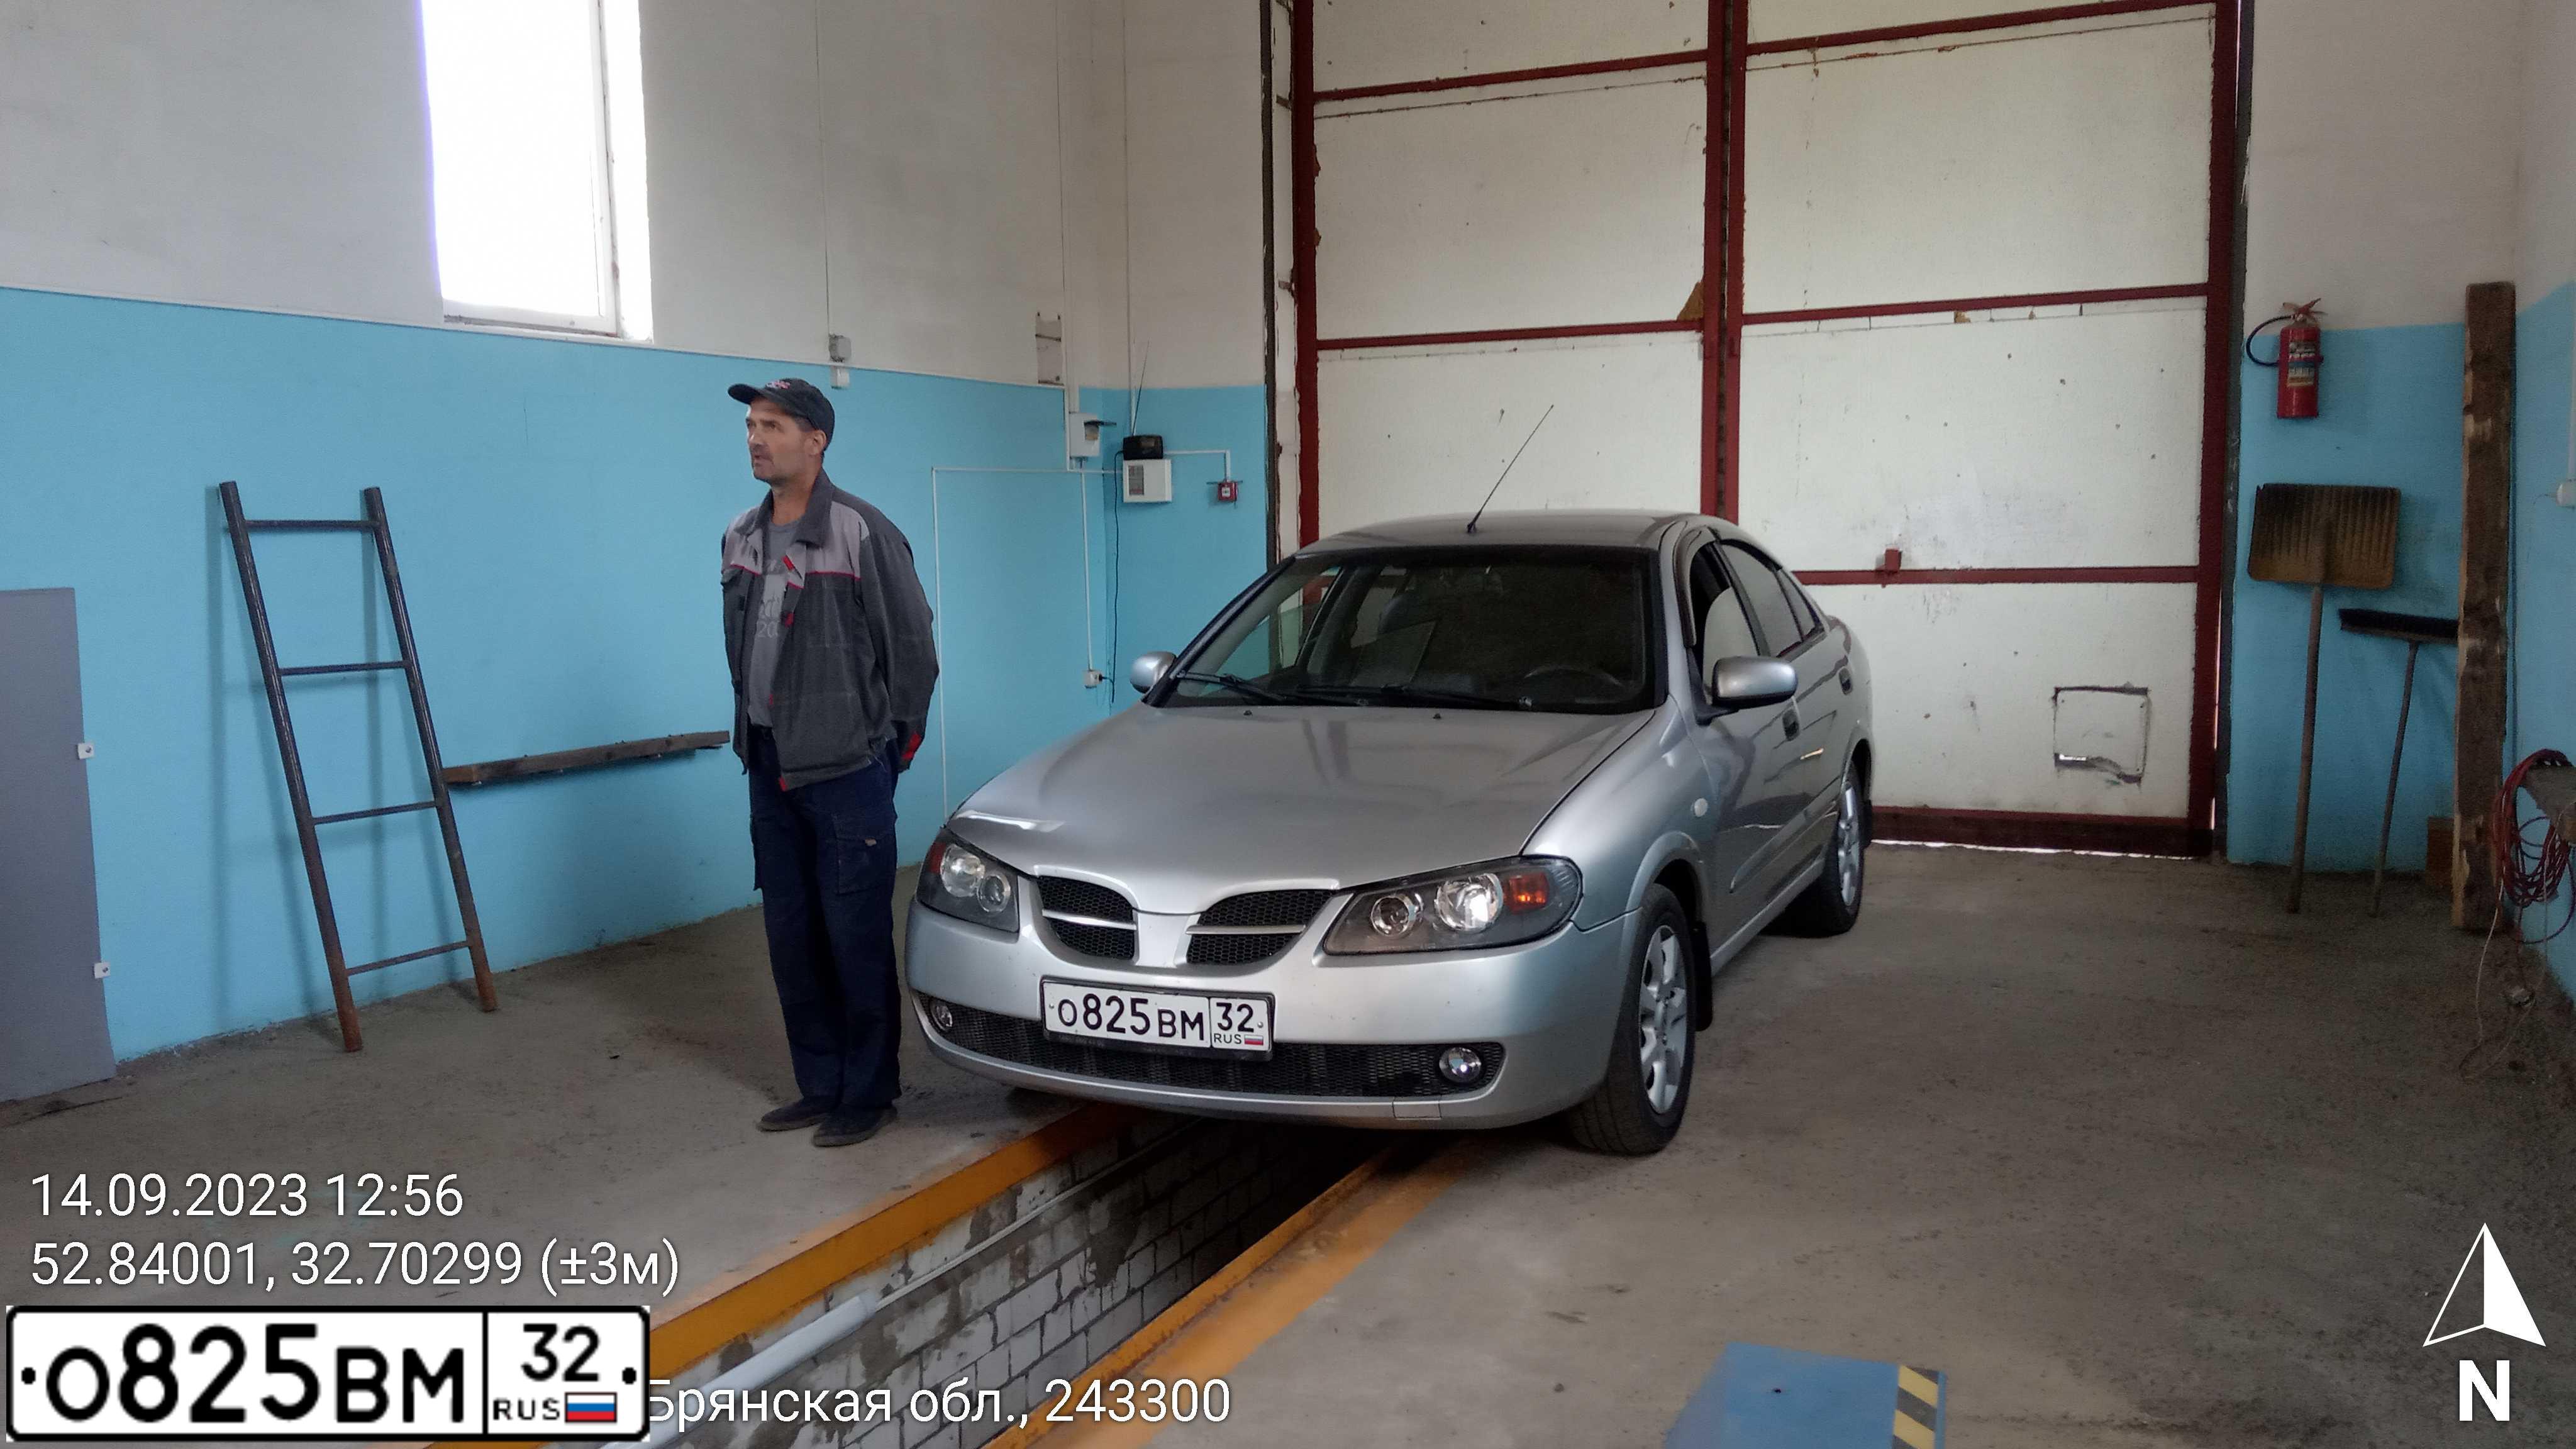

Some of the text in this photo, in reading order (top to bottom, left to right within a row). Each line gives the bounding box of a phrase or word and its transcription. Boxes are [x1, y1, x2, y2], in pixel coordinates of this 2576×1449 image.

[1058, 993, 1254, 1041] О825ВМ 32
[1214, 1033, 1242, 1044] RUS
